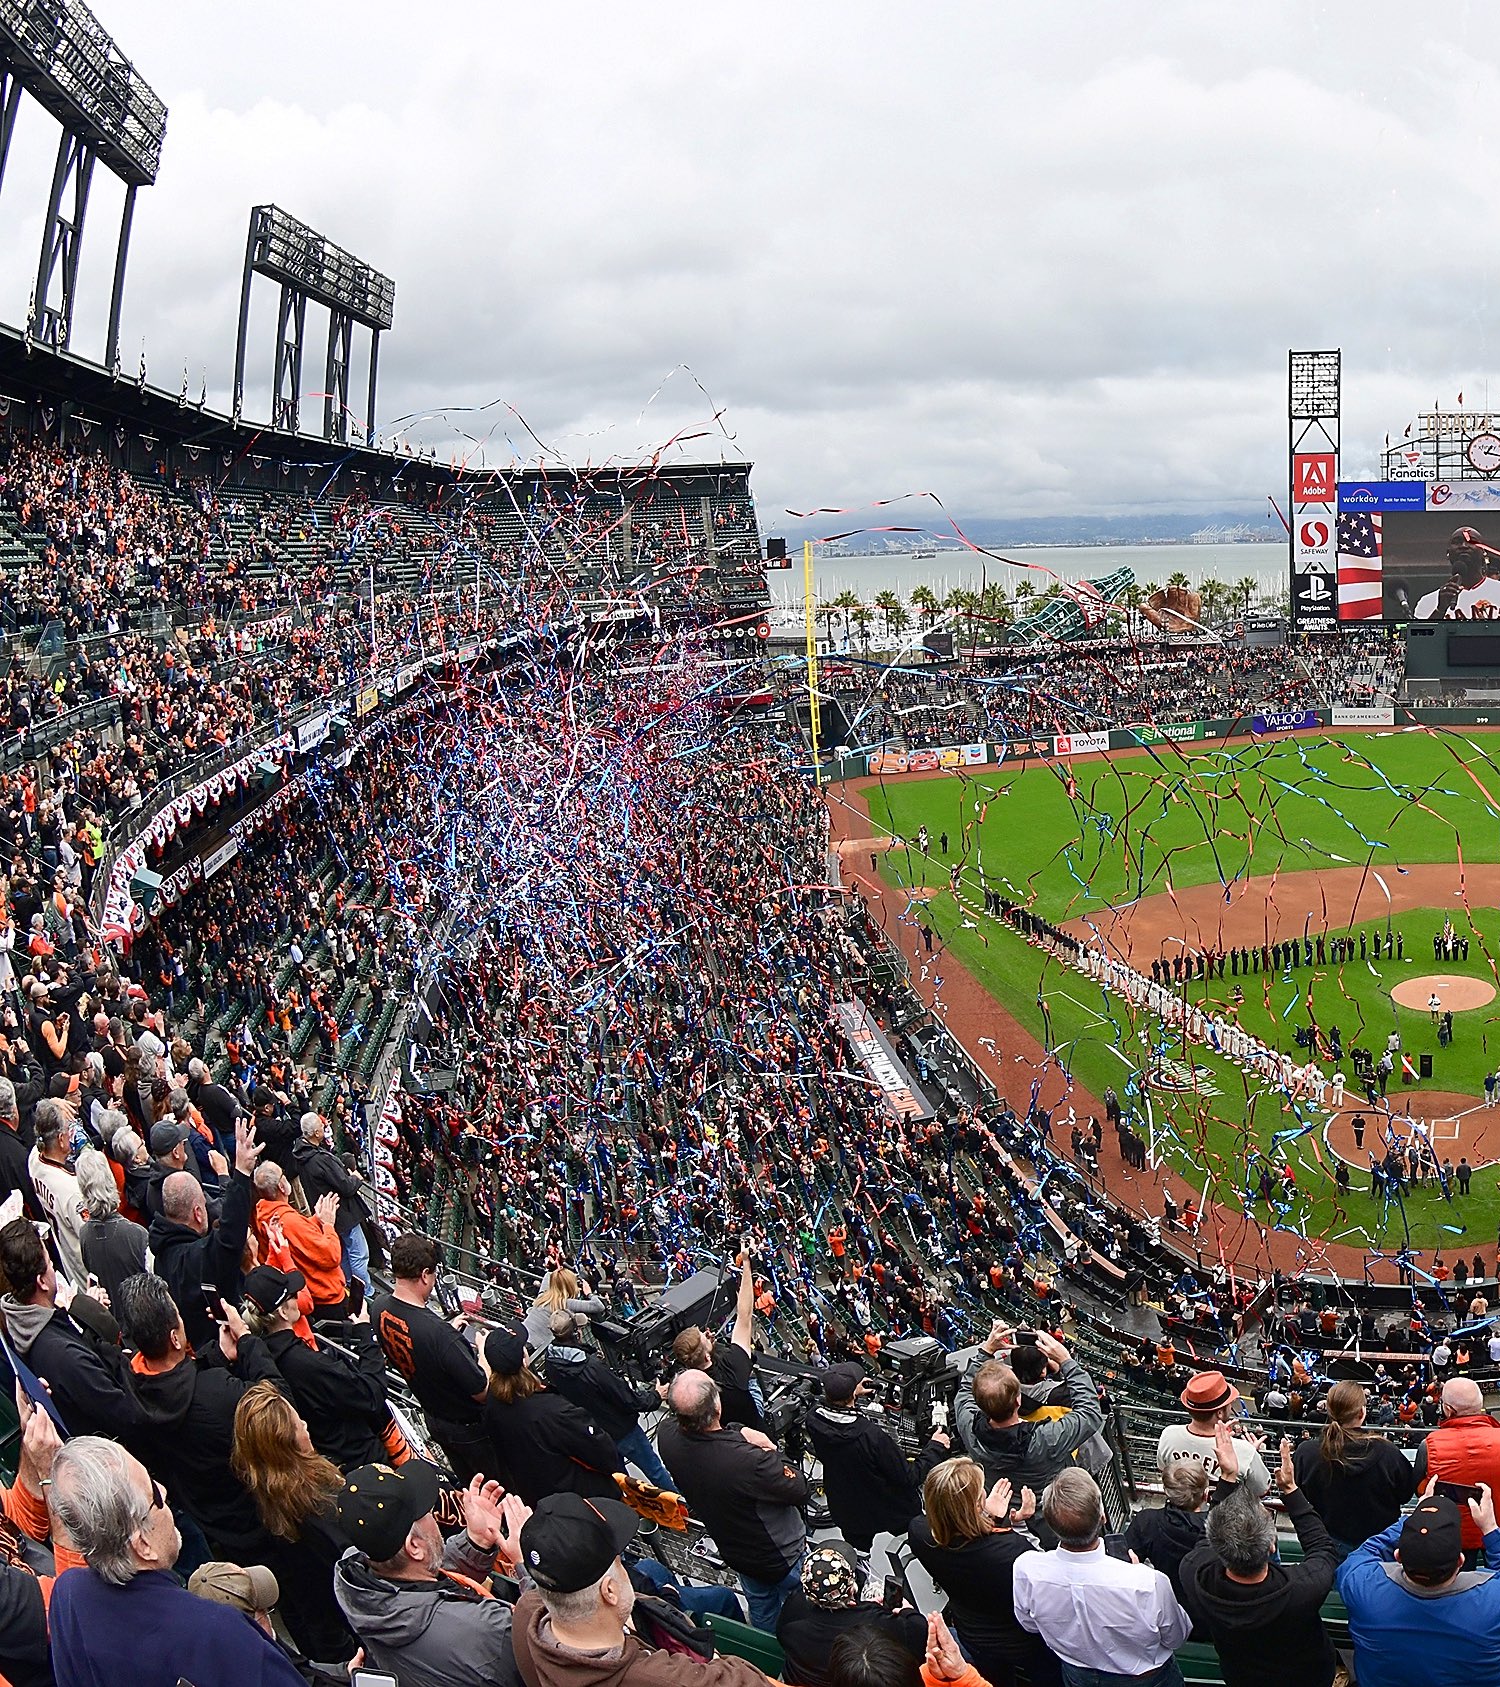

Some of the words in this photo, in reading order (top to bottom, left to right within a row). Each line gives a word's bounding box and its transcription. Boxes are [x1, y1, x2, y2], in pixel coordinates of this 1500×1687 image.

[1426, 413, 1494, 437] ORACLE
[1390, 468, 1435, 478] Fanatics
[1302, 487, 1327, 495] Adobe
[1343, 494, 1379, 504] workday
[1263, 712, 1306, 728] YAHOO!
[1476, 716, 1489, 724] 399
[1153, 724, 1196, 740] National
[1074, 738, 1107, 748] TOYOTA
[820, 774, 832, 782] 339
